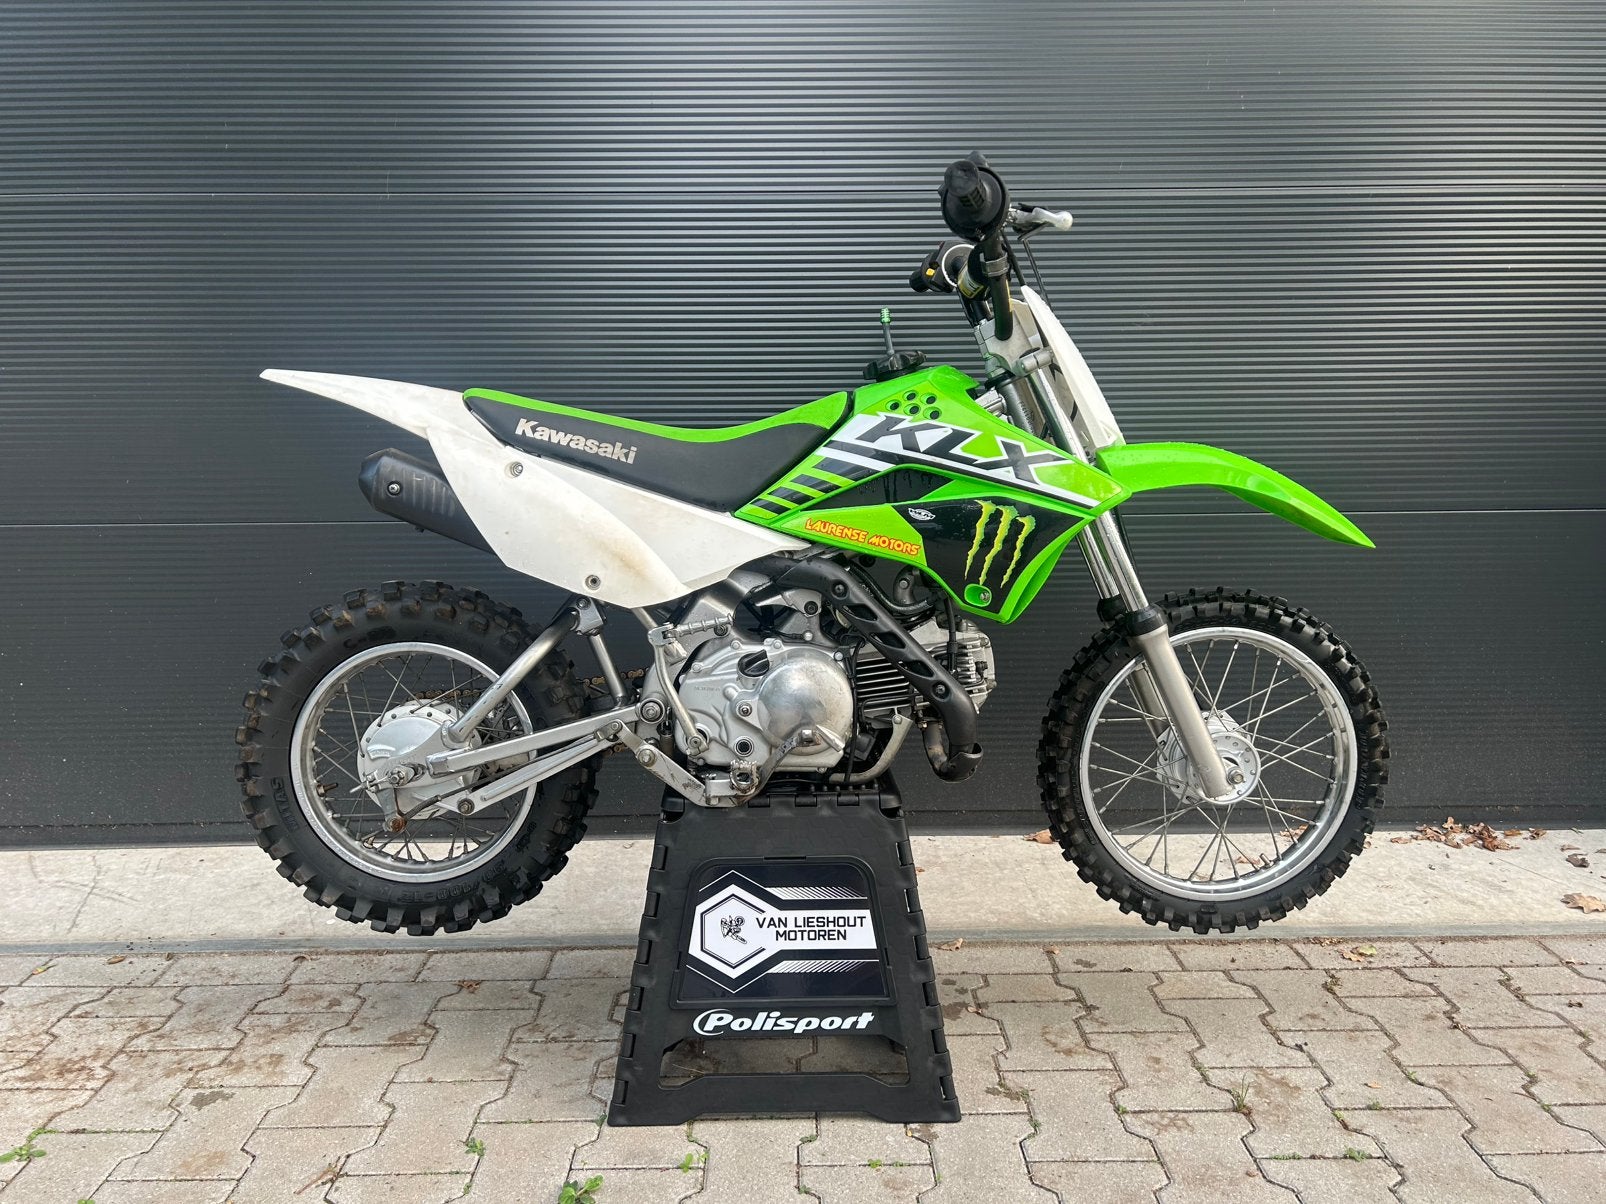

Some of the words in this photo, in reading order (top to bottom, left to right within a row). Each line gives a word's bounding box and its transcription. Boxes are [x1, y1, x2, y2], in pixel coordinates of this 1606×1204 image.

[514, 418, 638, 464] Kawasaki
[855, 413, 1073, 485] KLX
[805, 518, 868, 543] LAURENSE
[868, 534, 921, 555] MOTORS
[756, 917, 788, 929] VAN
[795, 916, 867, 928] LIESHOUT
[775, 929, 847, 941] MOTOREN
[694, 1009, 875, 1035] Polisport
